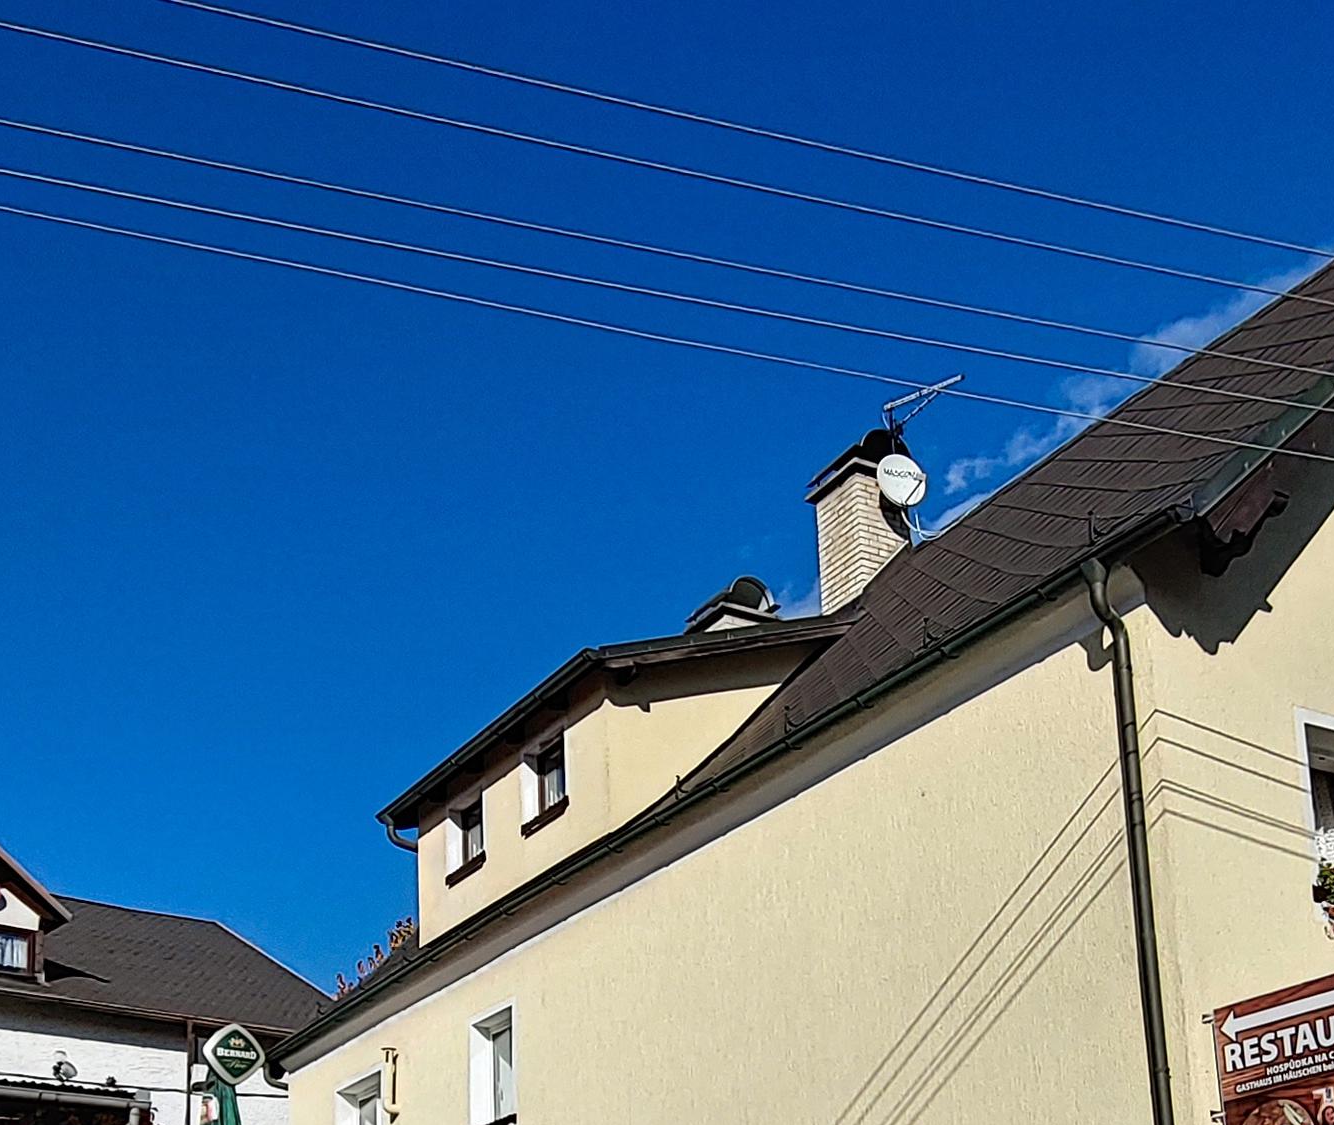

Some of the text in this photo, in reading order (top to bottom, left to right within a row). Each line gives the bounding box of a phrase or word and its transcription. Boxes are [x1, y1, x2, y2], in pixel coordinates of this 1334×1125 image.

[216, 1046, 257, 1060] BERNARD
[1315, 1052, 1329, 1064] NA
[1235, 1079, 1273, 1093] GASTHAUS
[1273, 1074, 1283, 1085] IM
